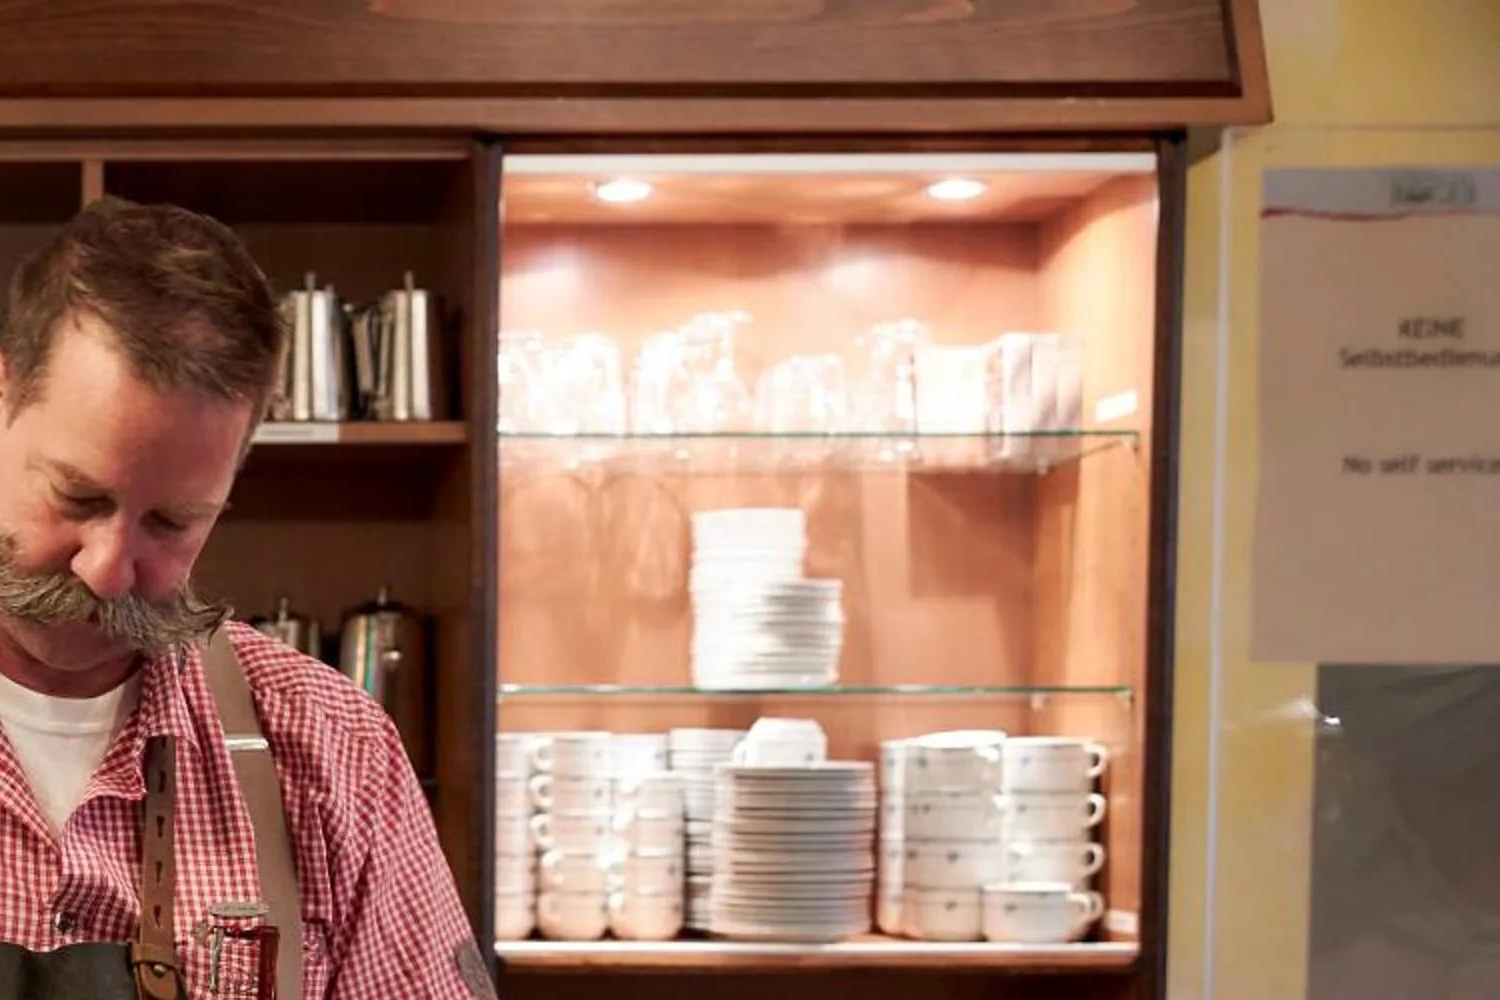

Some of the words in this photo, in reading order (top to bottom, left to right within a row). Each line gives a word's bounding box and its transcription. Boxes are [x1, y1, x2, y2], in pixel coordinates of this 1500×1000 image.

[1399, 317, 1464, 339] KEINE
[1343, 455, 1371, 474] No
[1379, 454, 1422, 474] self
